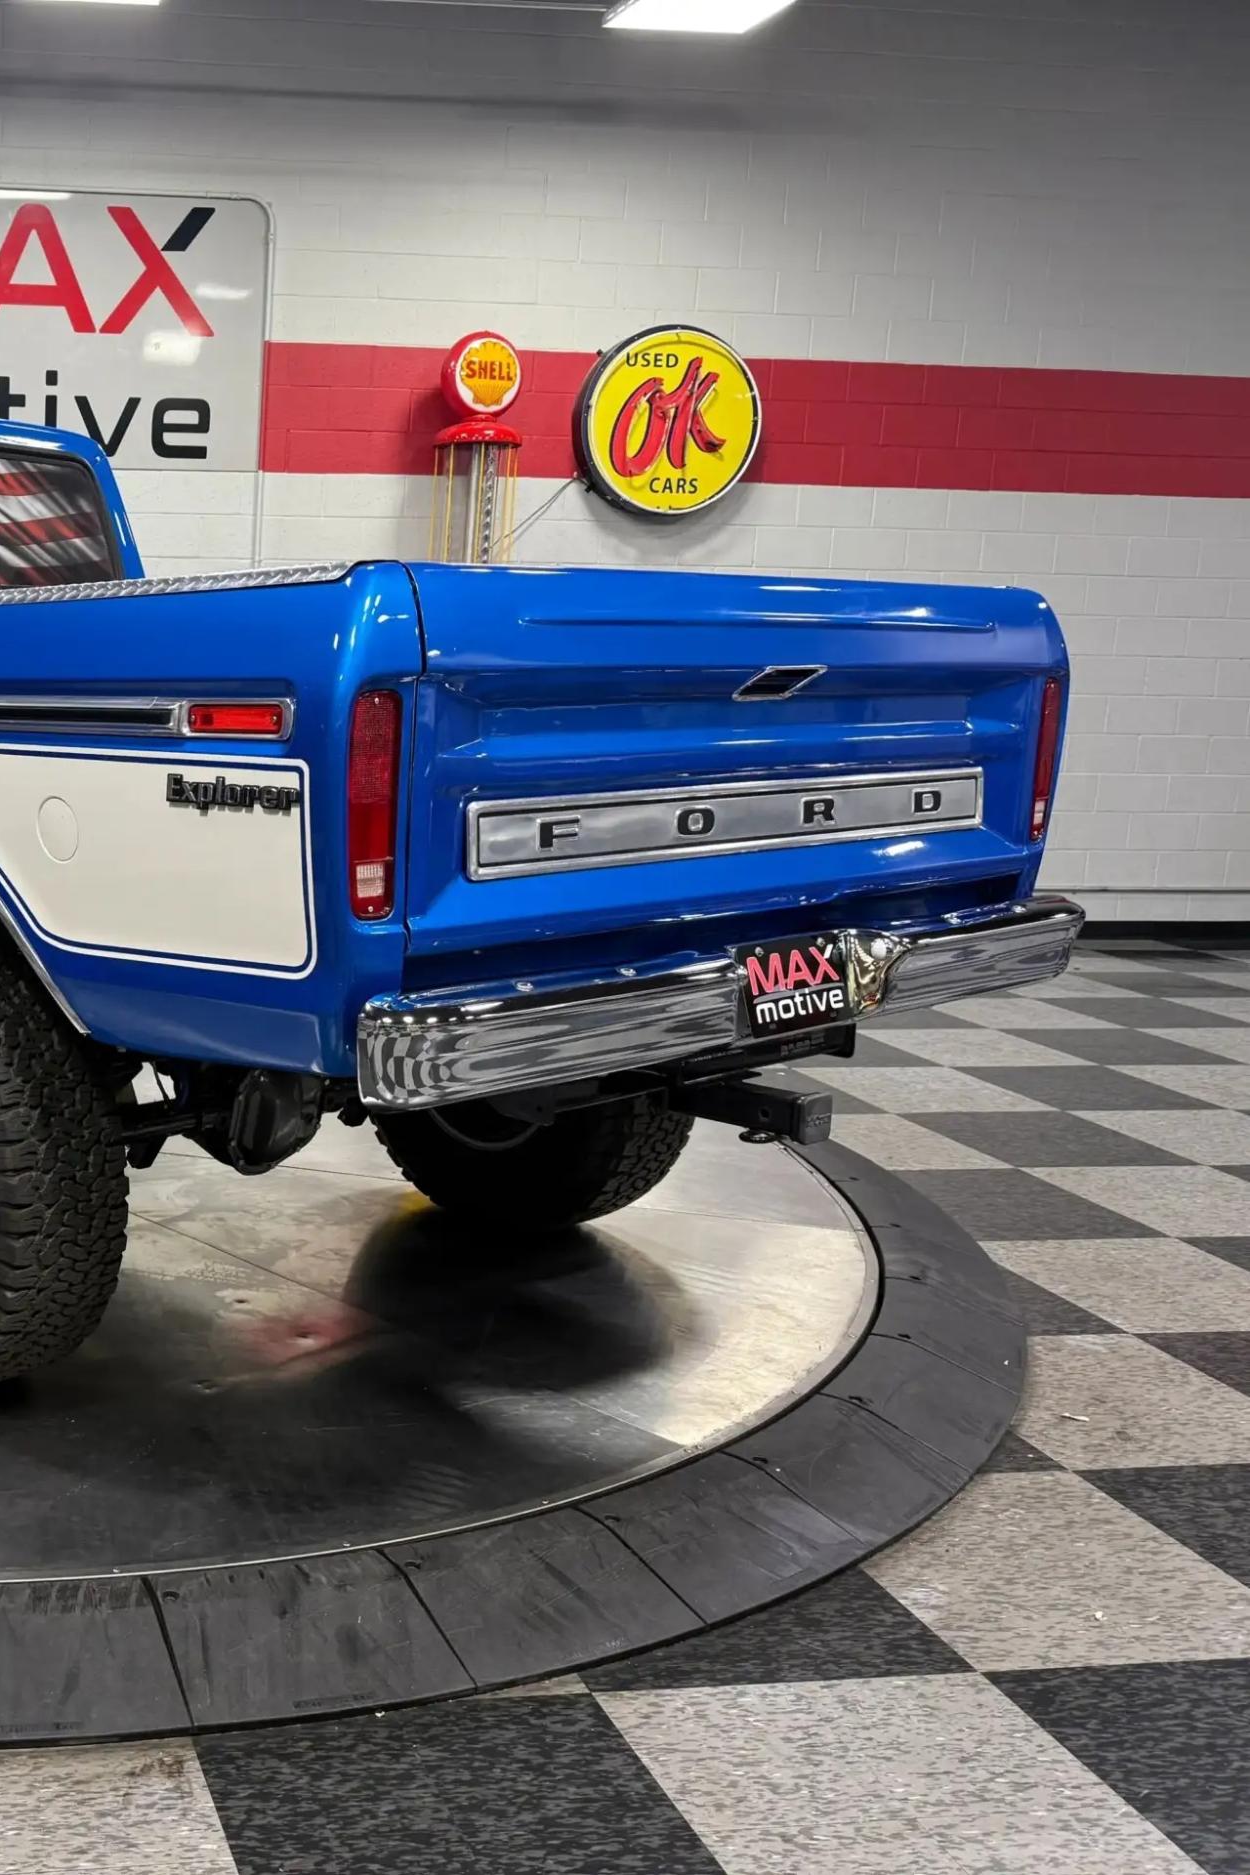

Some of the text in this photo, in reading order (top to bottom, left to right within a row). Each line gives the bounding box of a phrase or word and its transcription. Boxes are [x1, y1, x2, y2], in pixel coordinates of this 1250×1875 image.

[465, 359, 514, 383] SHELL
[626, 352, 679, 368] USED
[649, 477, 699, 494] CARS
[165, 773, 302, 815] Explorer
[536, 789, 943, 852] FORD
[746, 944, 840, 996] MAX
[755, 988, 845, 1025] motive
